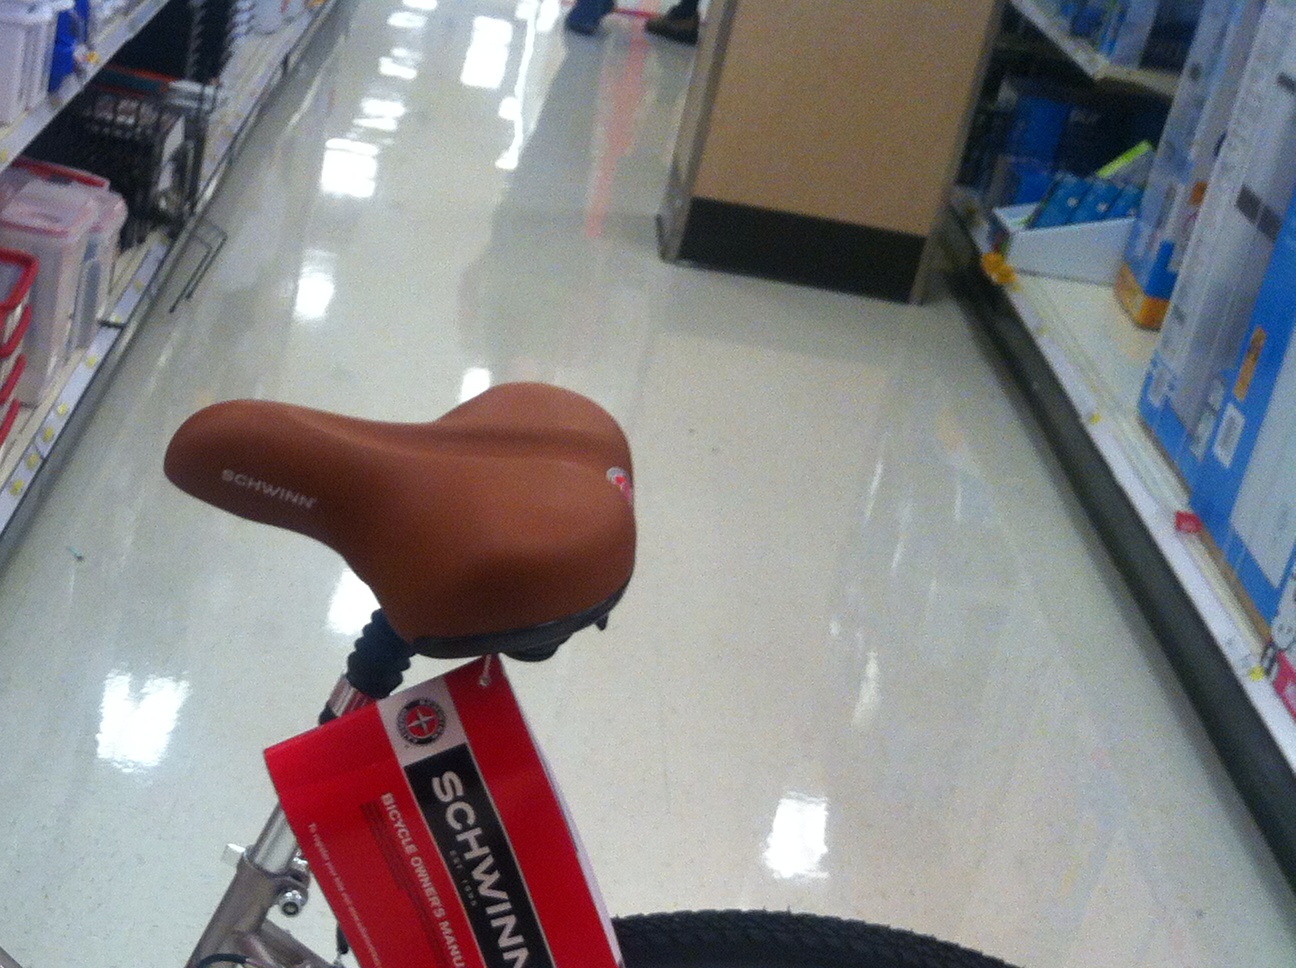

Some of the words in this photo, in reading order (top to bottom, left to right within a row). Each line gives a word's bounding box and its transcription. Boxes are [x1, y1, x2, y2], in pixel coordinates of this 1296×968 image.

[222, 469, 317, 508] SCHWINN
[380, 792, 417, 856] BICYCLE
[409, 854, 446, 918] OWNER'S
